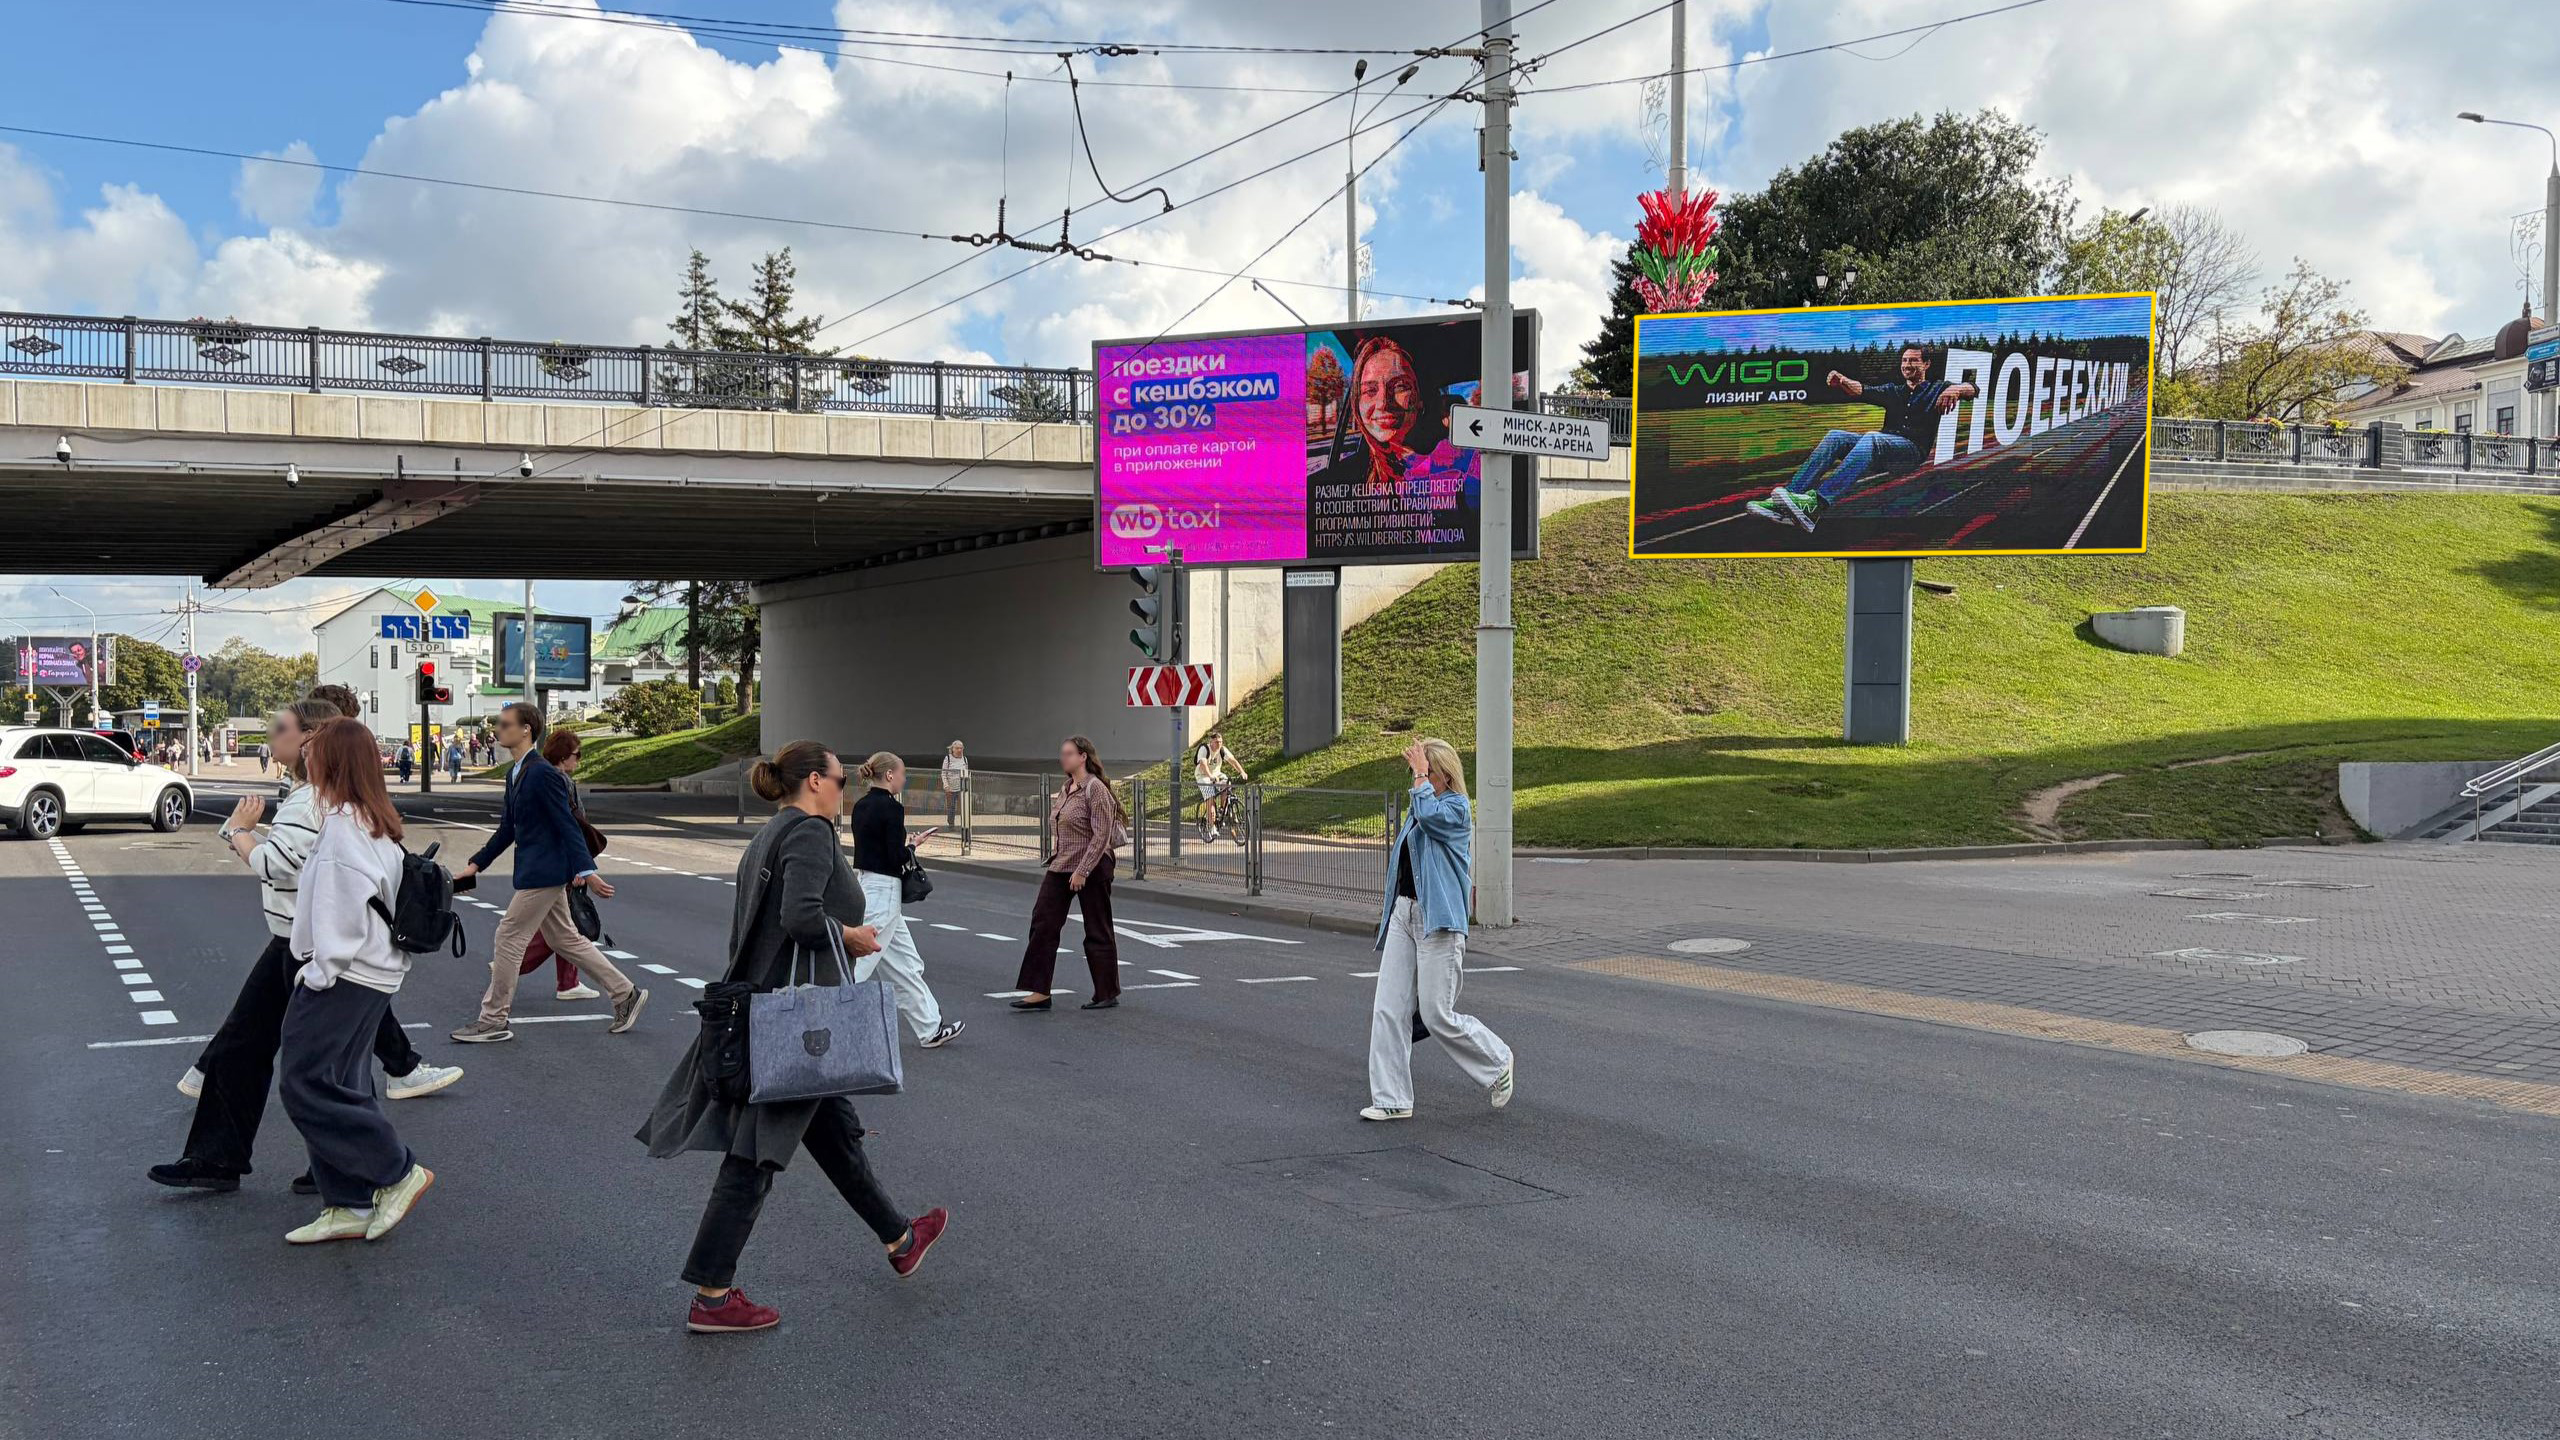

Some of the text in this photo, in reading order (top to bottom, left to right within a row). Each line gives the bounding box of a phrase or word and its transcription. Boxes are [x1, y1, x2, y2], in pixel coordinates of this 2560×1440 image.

[1113, 353, 1226, 377] поездки
[1667, 359, 1809, 386] WIGO
[1113, 376, 1276, 404] с кешбэком
[1705, 389, 1808, 404] ЛИЗИНГ АВТО
[1934, 348, 2130, 466] ПОЕЕЕХАЛИ
[1113, 404, 1212, 434] до 30%
[1503, 416, 1591, 438] МІНСК-АРЭНА
[1114, 437, 1256, 460] при оплате картой
[1503, 432, 1594, 453] МИНСК-АРЕНА
[1114, 457, 1222, 475] в приложении
[1315, 478, 1464, 499] РАЗМЕР КЕШБЭКА ОПРЕДЕЛЯЕТСЯ
[1315, 495, 1457, 515] В СООТВЕТСТВИИ С ПРАВИЛАМИ
[1115, 502, 1221, 531] wb taxi
[1315, 512, 1436, 531] ПРОГРАММЫ ПРИВИЛЕГИЙ:
